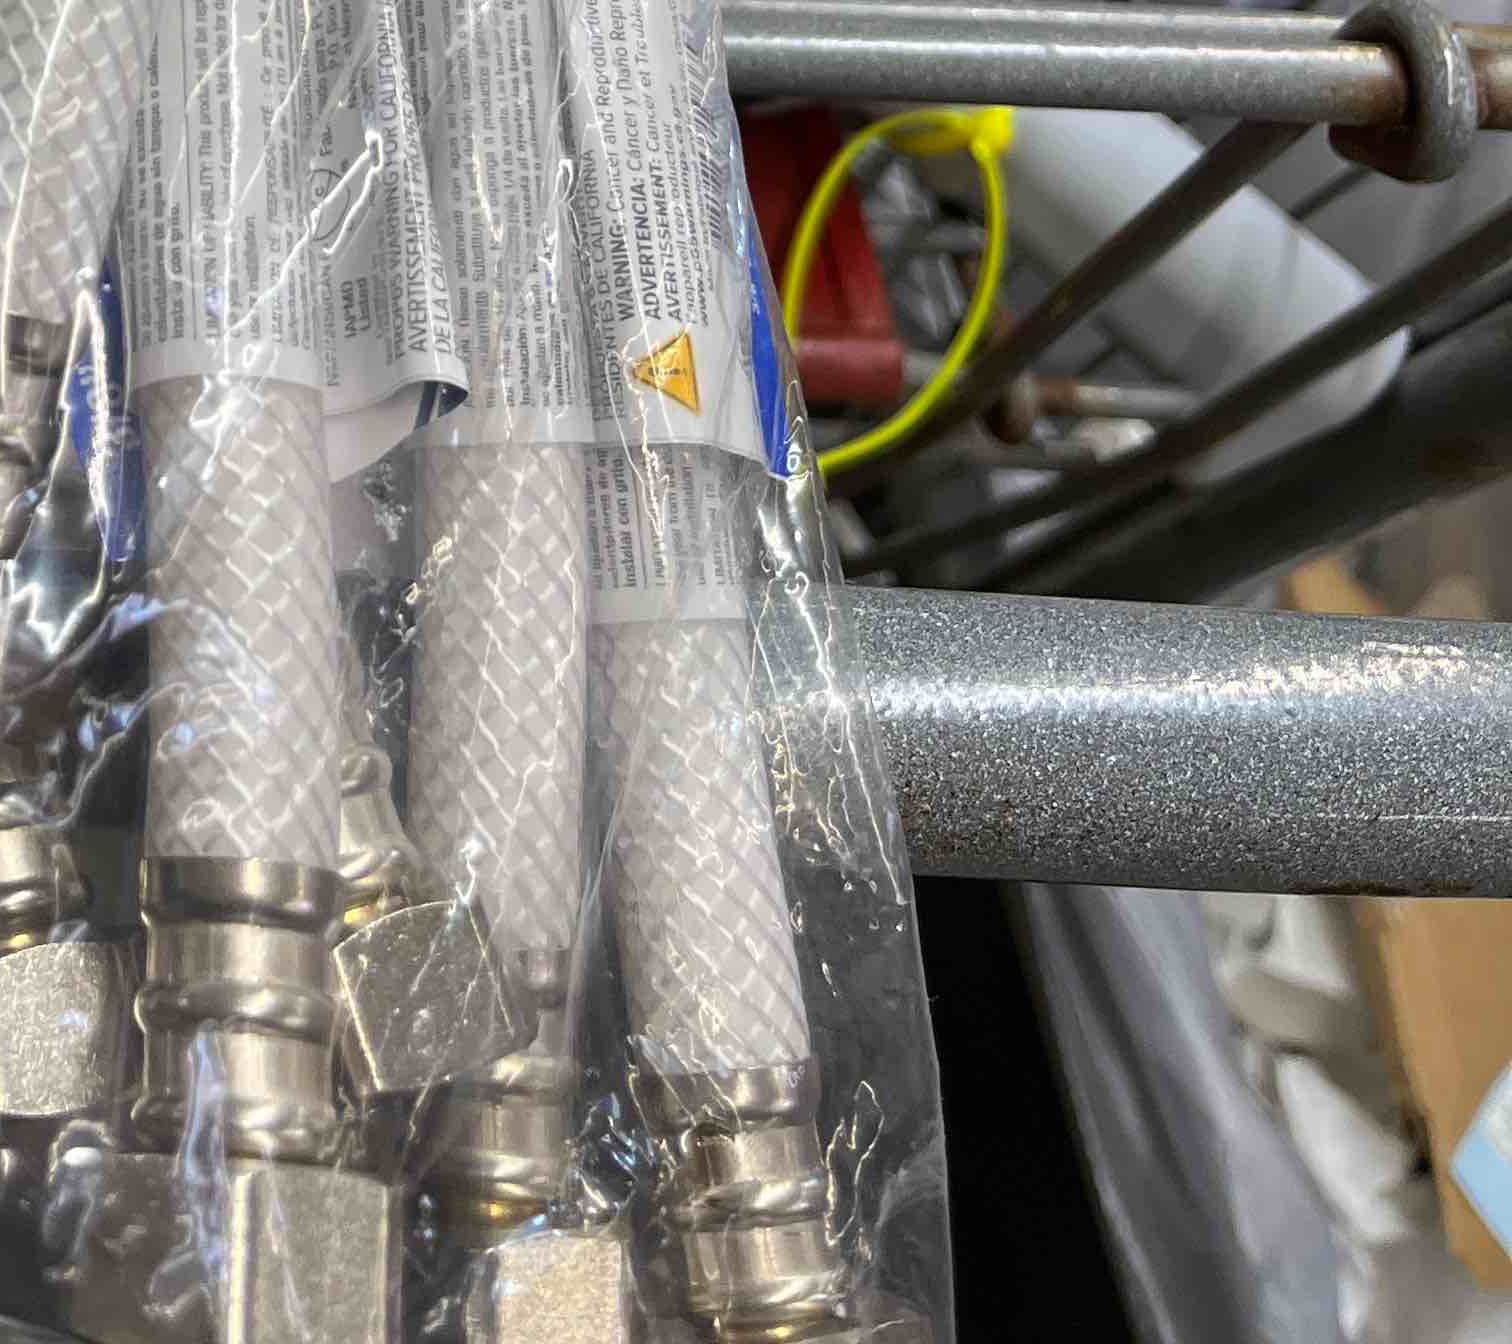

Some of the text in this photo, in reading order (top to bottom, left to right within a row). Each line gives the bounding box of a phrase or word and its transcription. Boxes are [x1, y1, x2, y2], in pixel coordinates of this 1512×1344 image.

[375, 13, 398, 121] CALIFORNIA
[611, 45, 633, 90] Daño
[638, 70, 652, 88] et
[596, 112, 617, 145] and
[622, 95, 636, 105] y
[641, 92, 662, 152] Cancer
[620, 110, 643, 172] Cáncer
[581, 148, 606, 263] CALIFORNIA
[603, 151, 626, 213] Cancer
[169, 246, 183, 274] con
[608, 217, 636, 322] WARNING:
[627, 175, 662, 322] ADVERTENCIA:
[648, 158, 683, 323] AVERTISSEMENT:
[403, 192, 428, 353] AVERTISSEMENT
[593, 269, 610, 294] DE
[431, 298, 452, 354] DE LA
